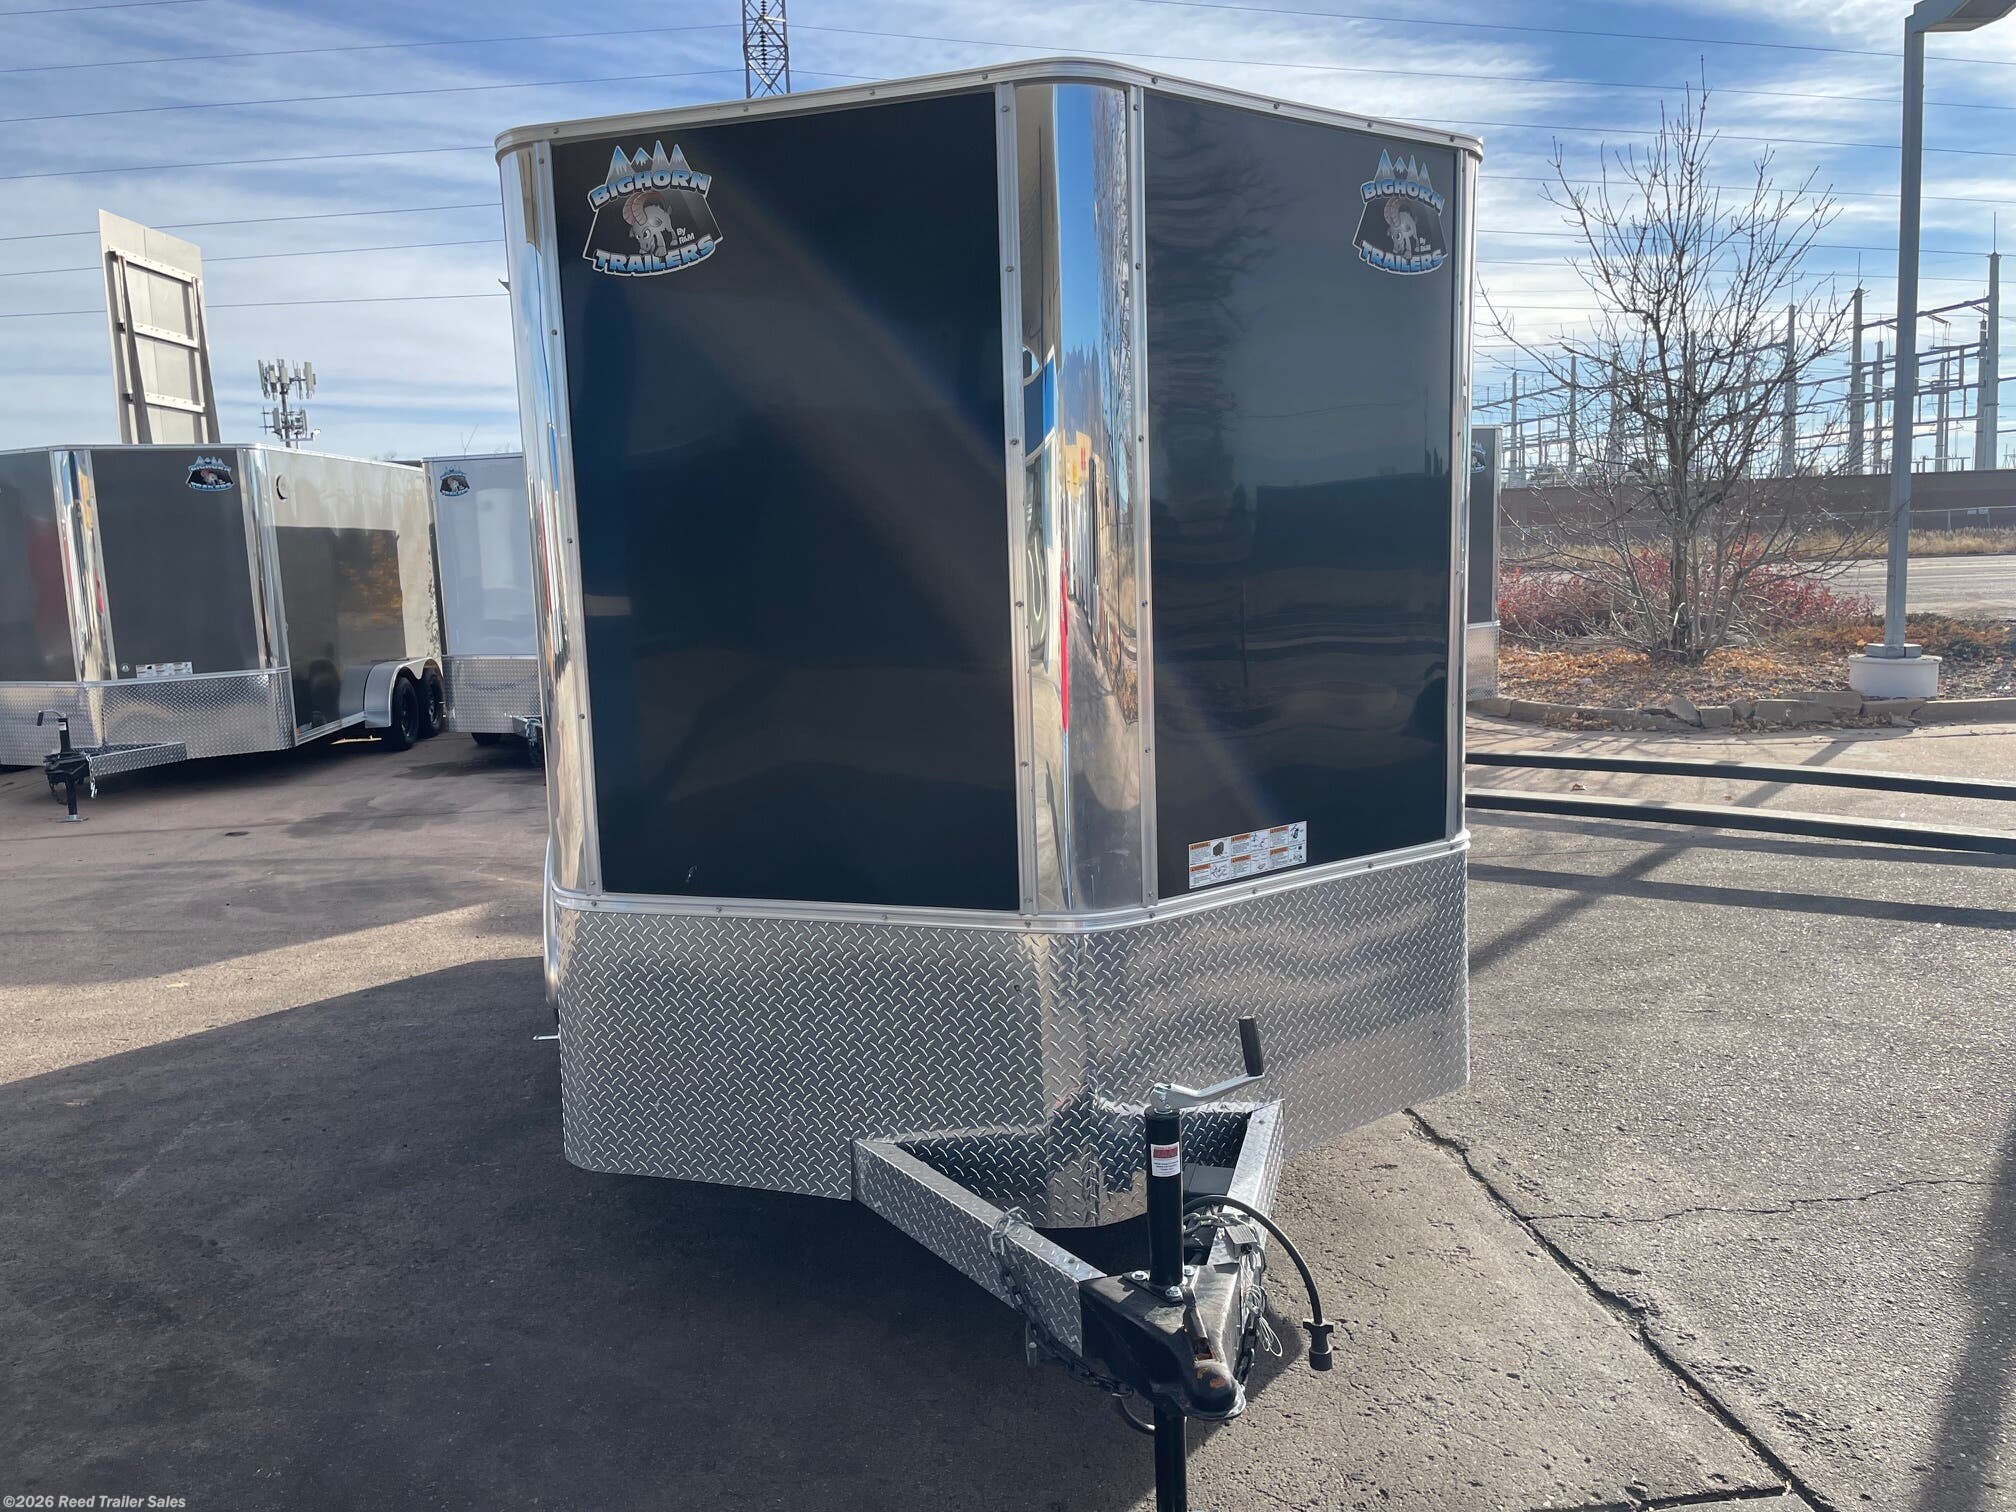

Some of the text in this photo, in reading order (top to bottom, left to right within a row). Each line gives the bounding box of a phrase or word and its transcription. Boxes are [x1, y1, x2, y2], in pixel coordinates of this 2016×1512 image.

[590, 169, 711, 208] BIGHORN
[1362, 178, 1444, 211] BIGHORN
[595, 236, 715, 273] TRAILERS
[1361, 240, 1443, 272] TRAILERS
